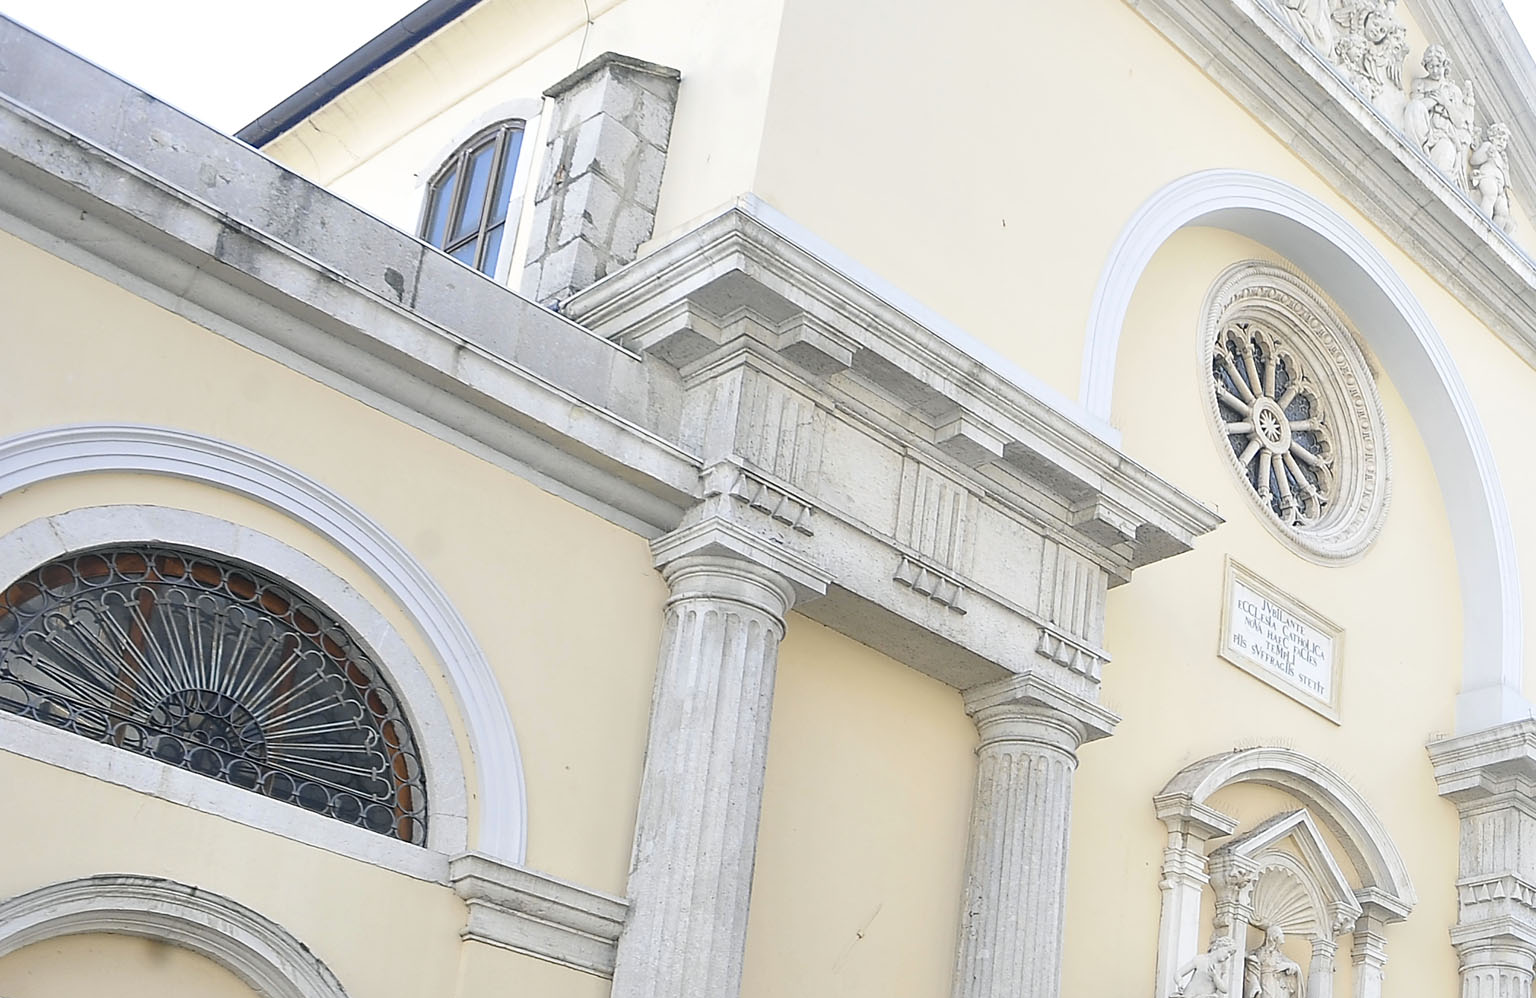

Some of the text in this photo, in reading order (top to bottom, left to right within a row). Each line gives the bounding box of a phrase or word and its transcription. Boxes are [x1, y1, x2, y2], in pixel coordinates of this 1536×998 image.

[1238, 600, 1276, 630] ECCLESIA
[1245, 616, 1262, 634] NOVA
[1267, 629, 1289, 649] HAEC
